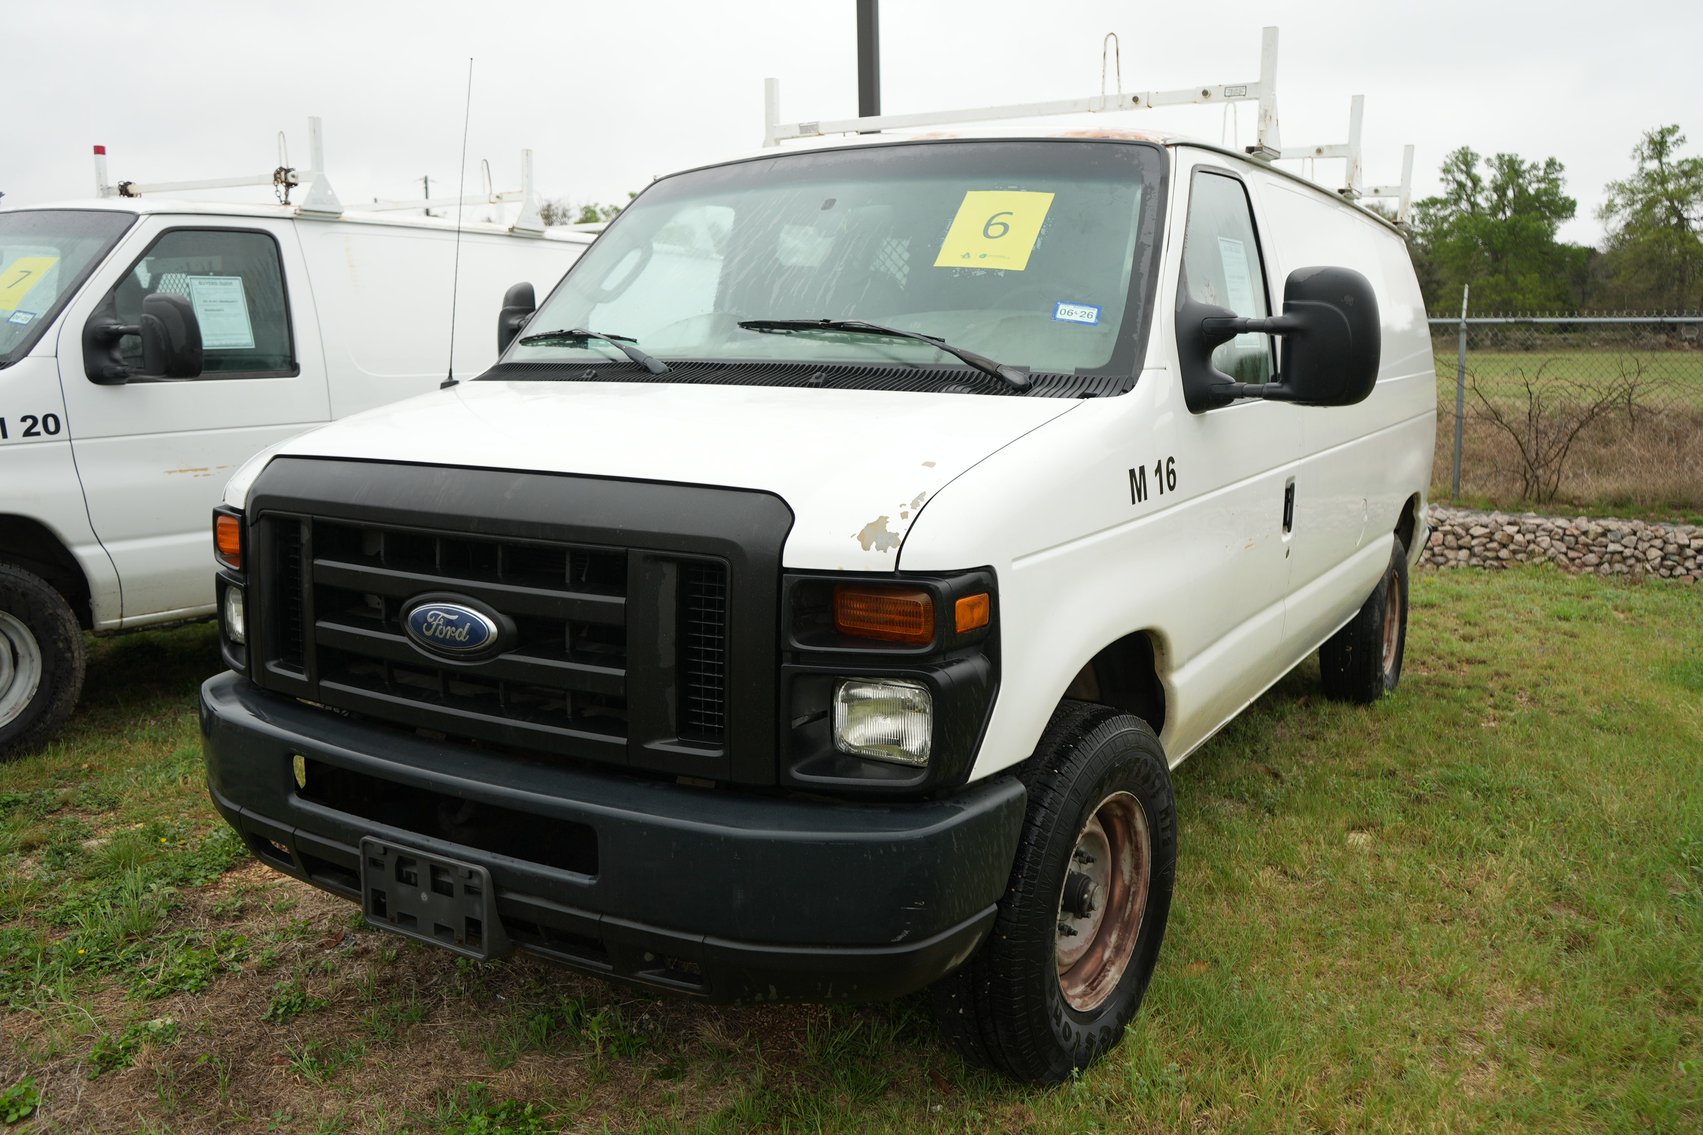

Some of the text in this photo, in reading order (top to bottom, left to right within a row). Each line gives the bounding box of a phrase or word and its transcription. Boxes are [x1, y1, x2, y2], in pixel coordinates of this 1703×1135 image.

[982, 211, 1014, 240] 6
[7, 270, 32, 289] 7
[20, 413, 61, 438] 20
[1128, 456, 1177, 505] M 16
[422, 610, 471, 642] Ford
